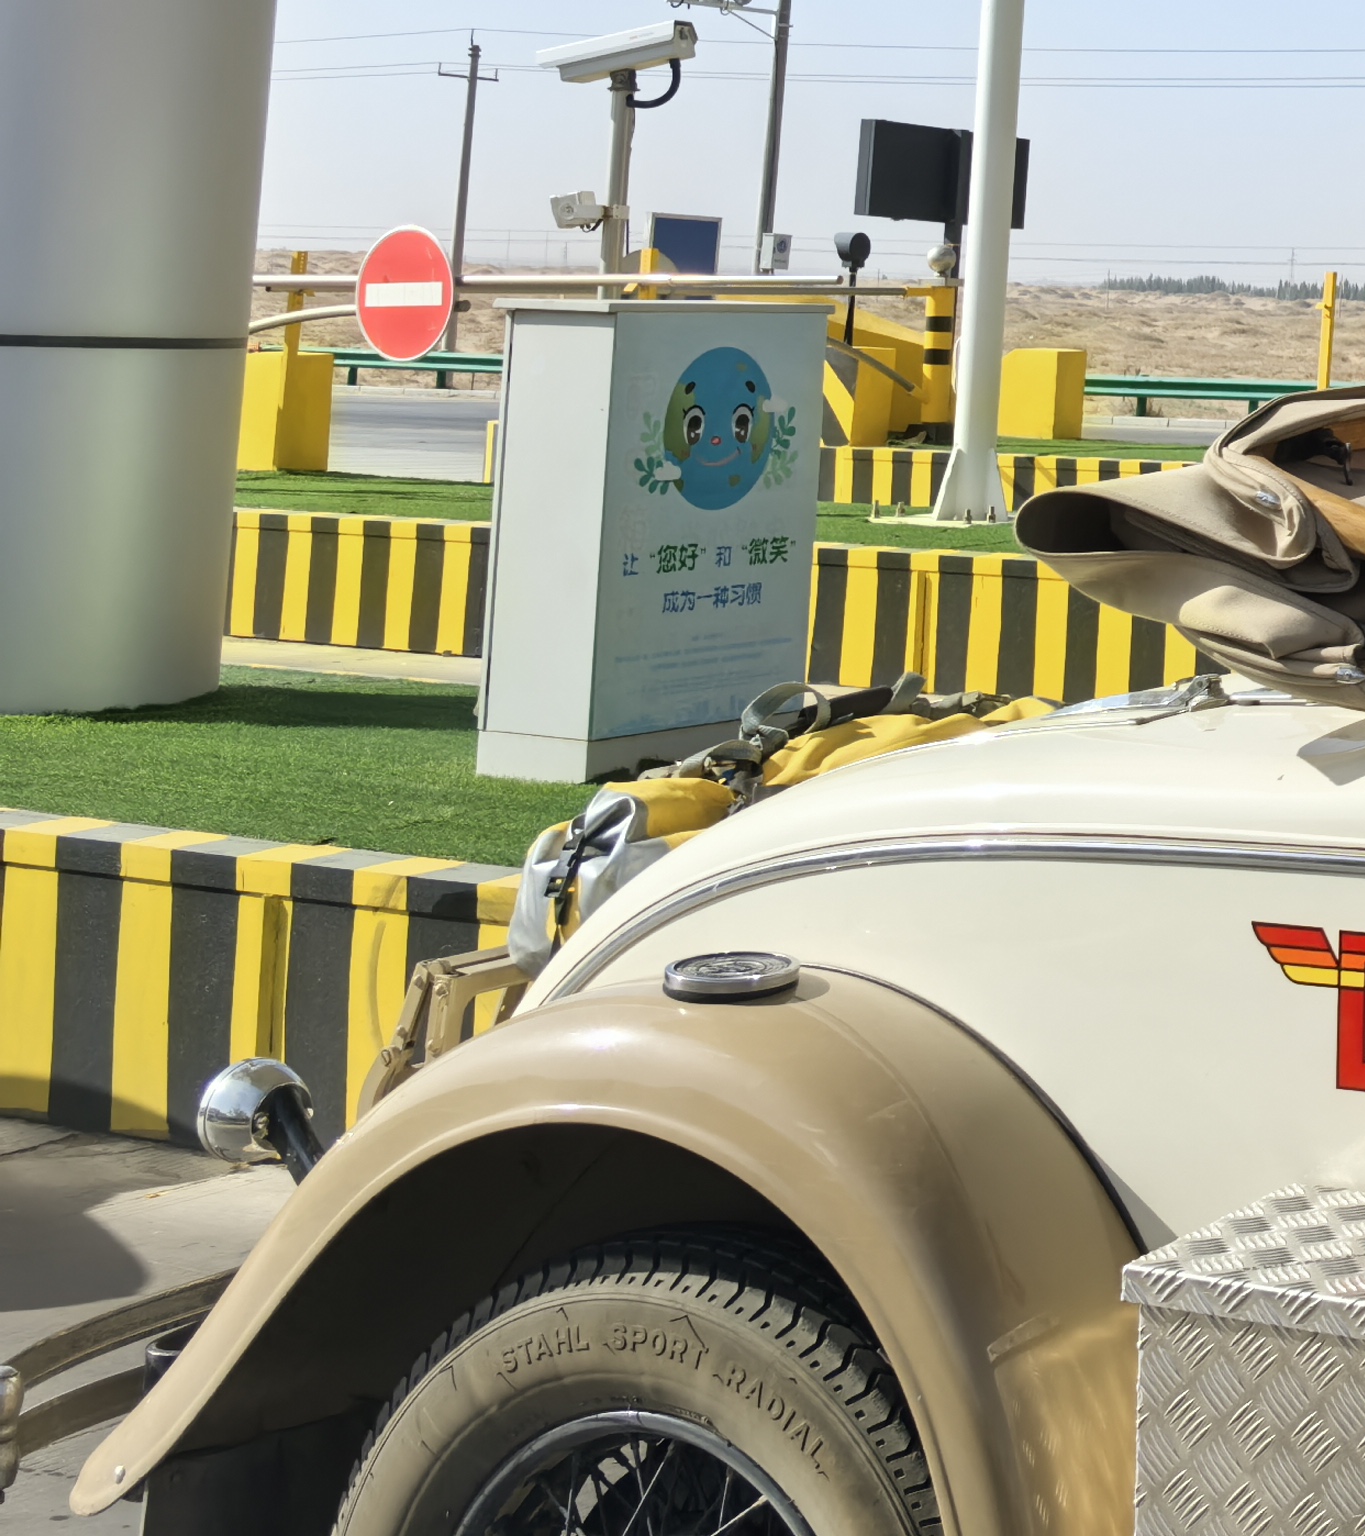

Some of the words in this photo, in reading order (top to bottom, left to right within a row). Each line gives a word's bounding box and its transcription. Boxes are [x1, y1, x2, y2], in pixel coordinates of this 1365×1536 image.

[662, 582, 763, 613] 成为一种习惯
[500, 1325, 590, 1375] STAHL
[610, 1323, 710, 1371] SPORT
[724, 1363, 828, 1469] RADIAL
